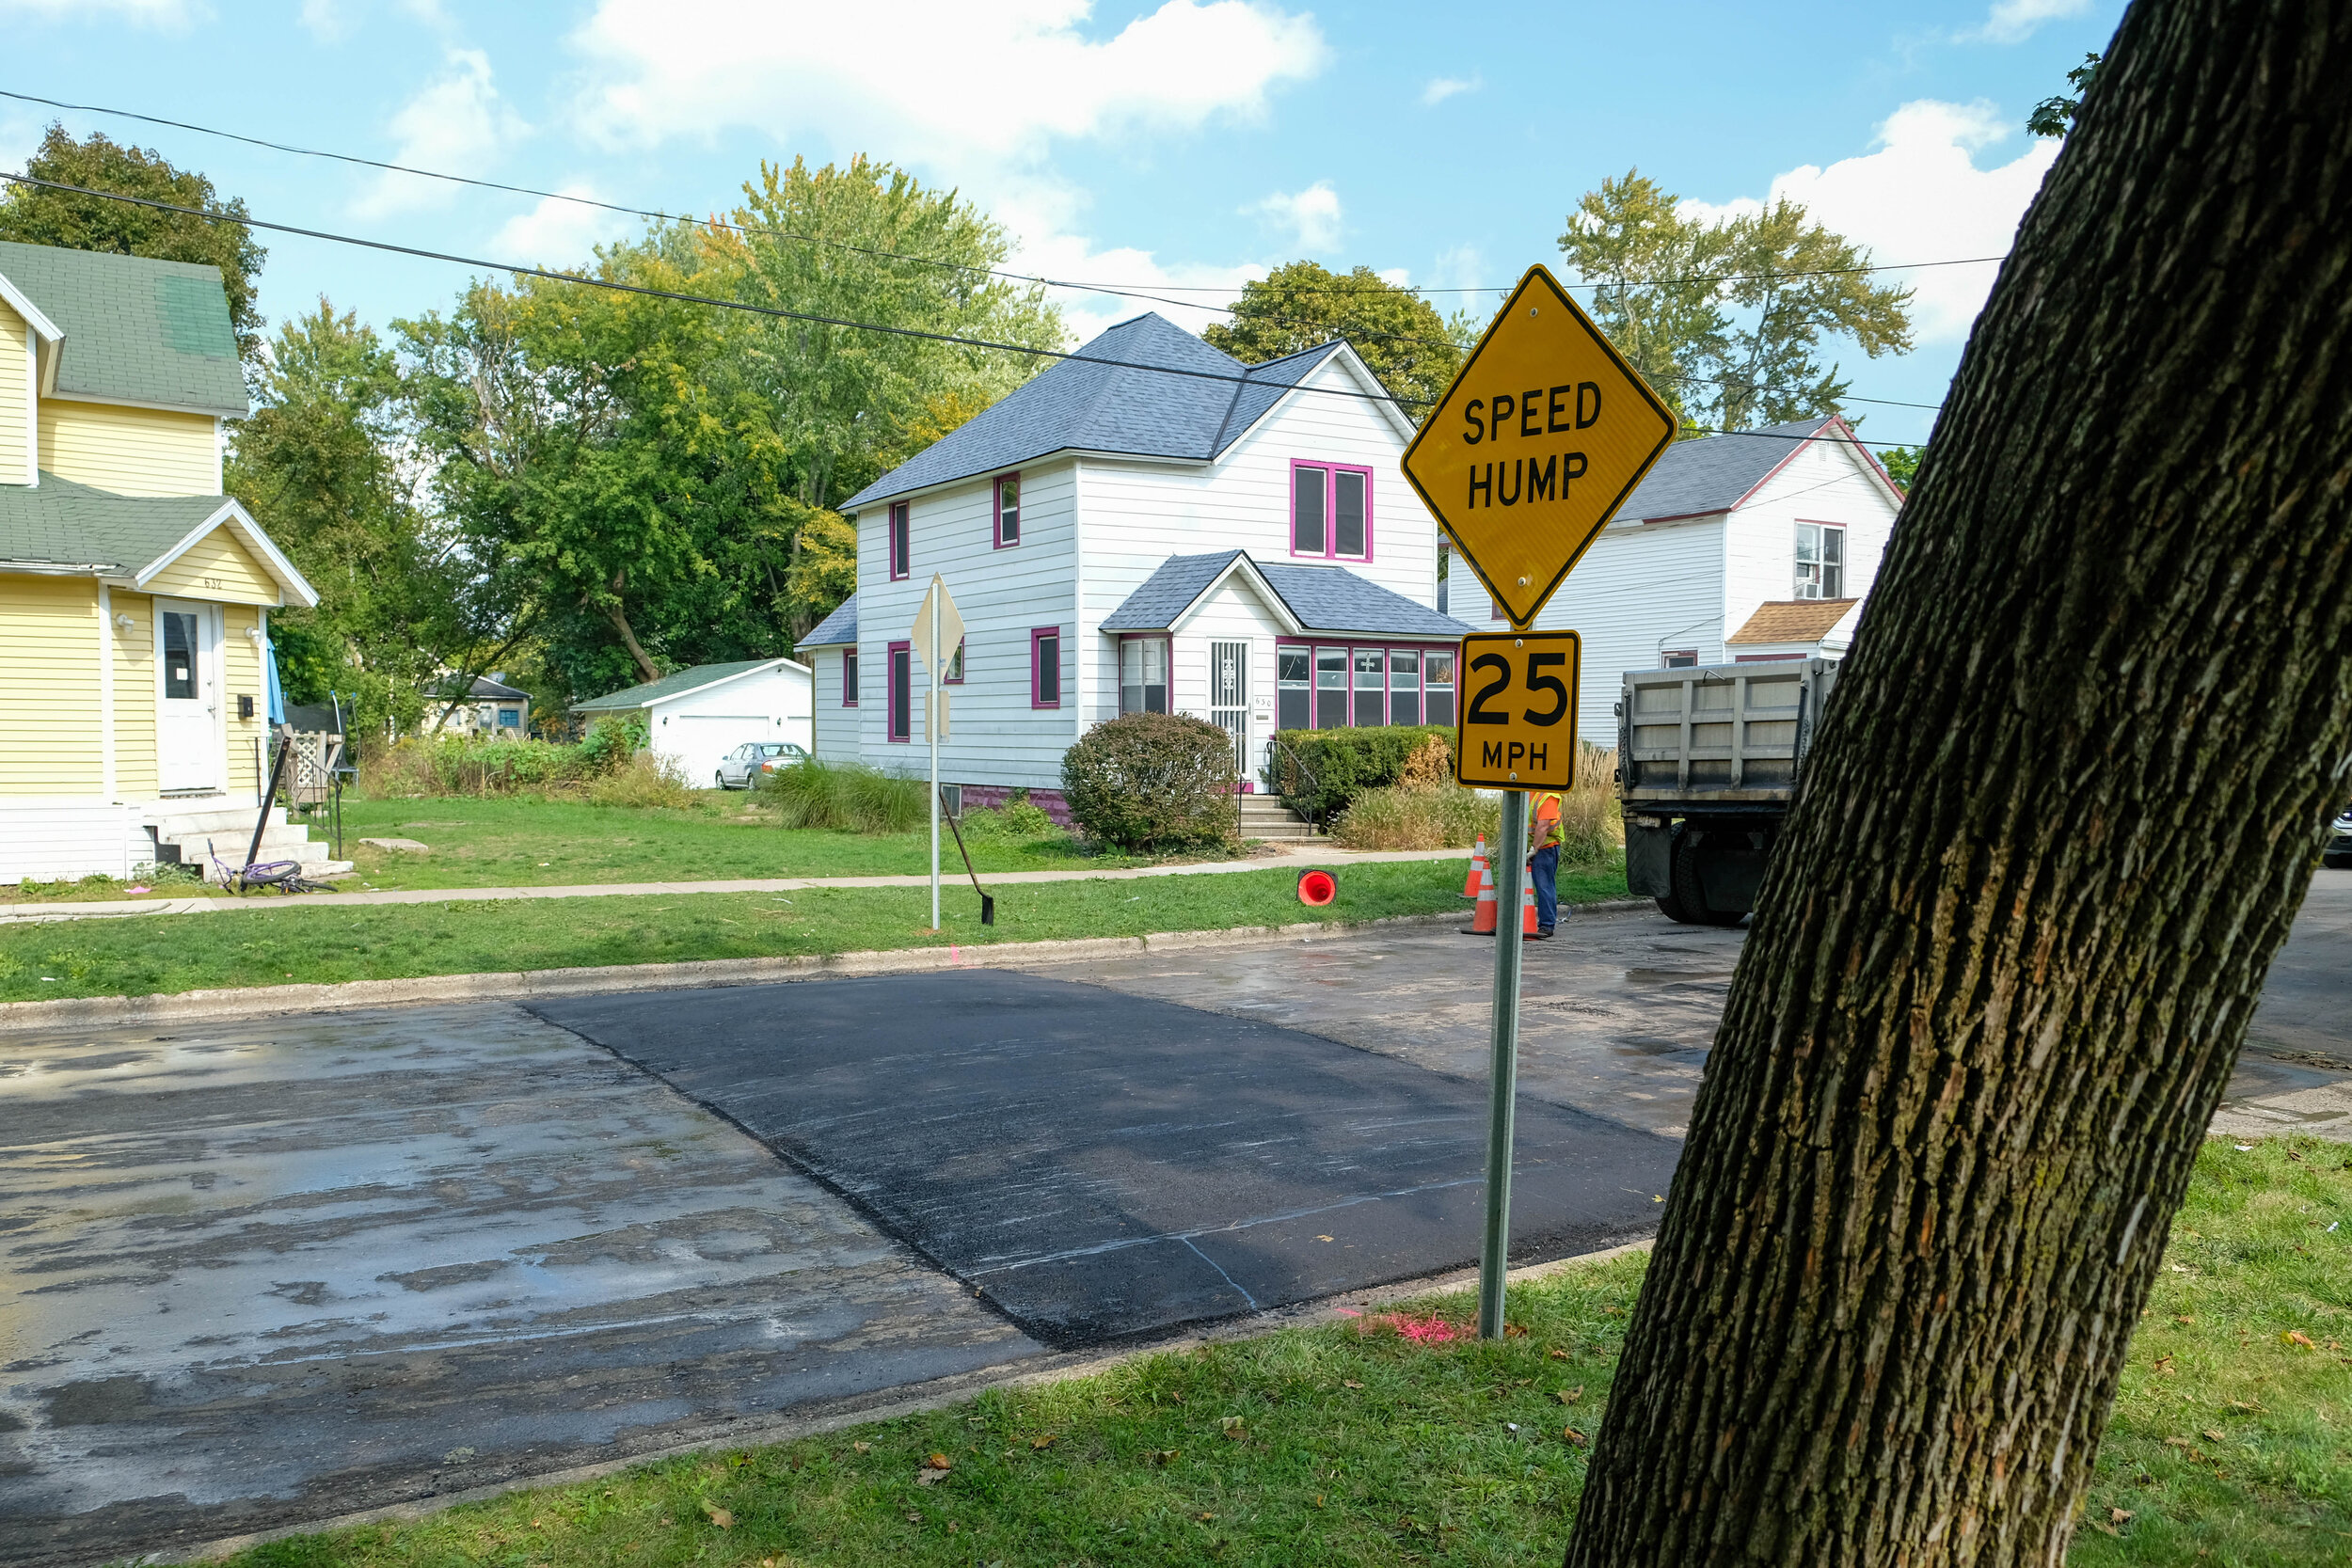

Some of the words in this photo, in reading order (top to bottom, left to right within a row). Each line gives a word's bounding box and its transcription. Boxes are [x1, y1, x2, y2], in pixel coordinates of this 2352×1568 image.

[1462, 380, 1602, 445] SPEED
[1468, 451, 1589, 510] HUMP
[205, 578, 222, 590] 632
[1467, 652, 1568, 727] 25
[1481, 739, 1549, 771] MPH
